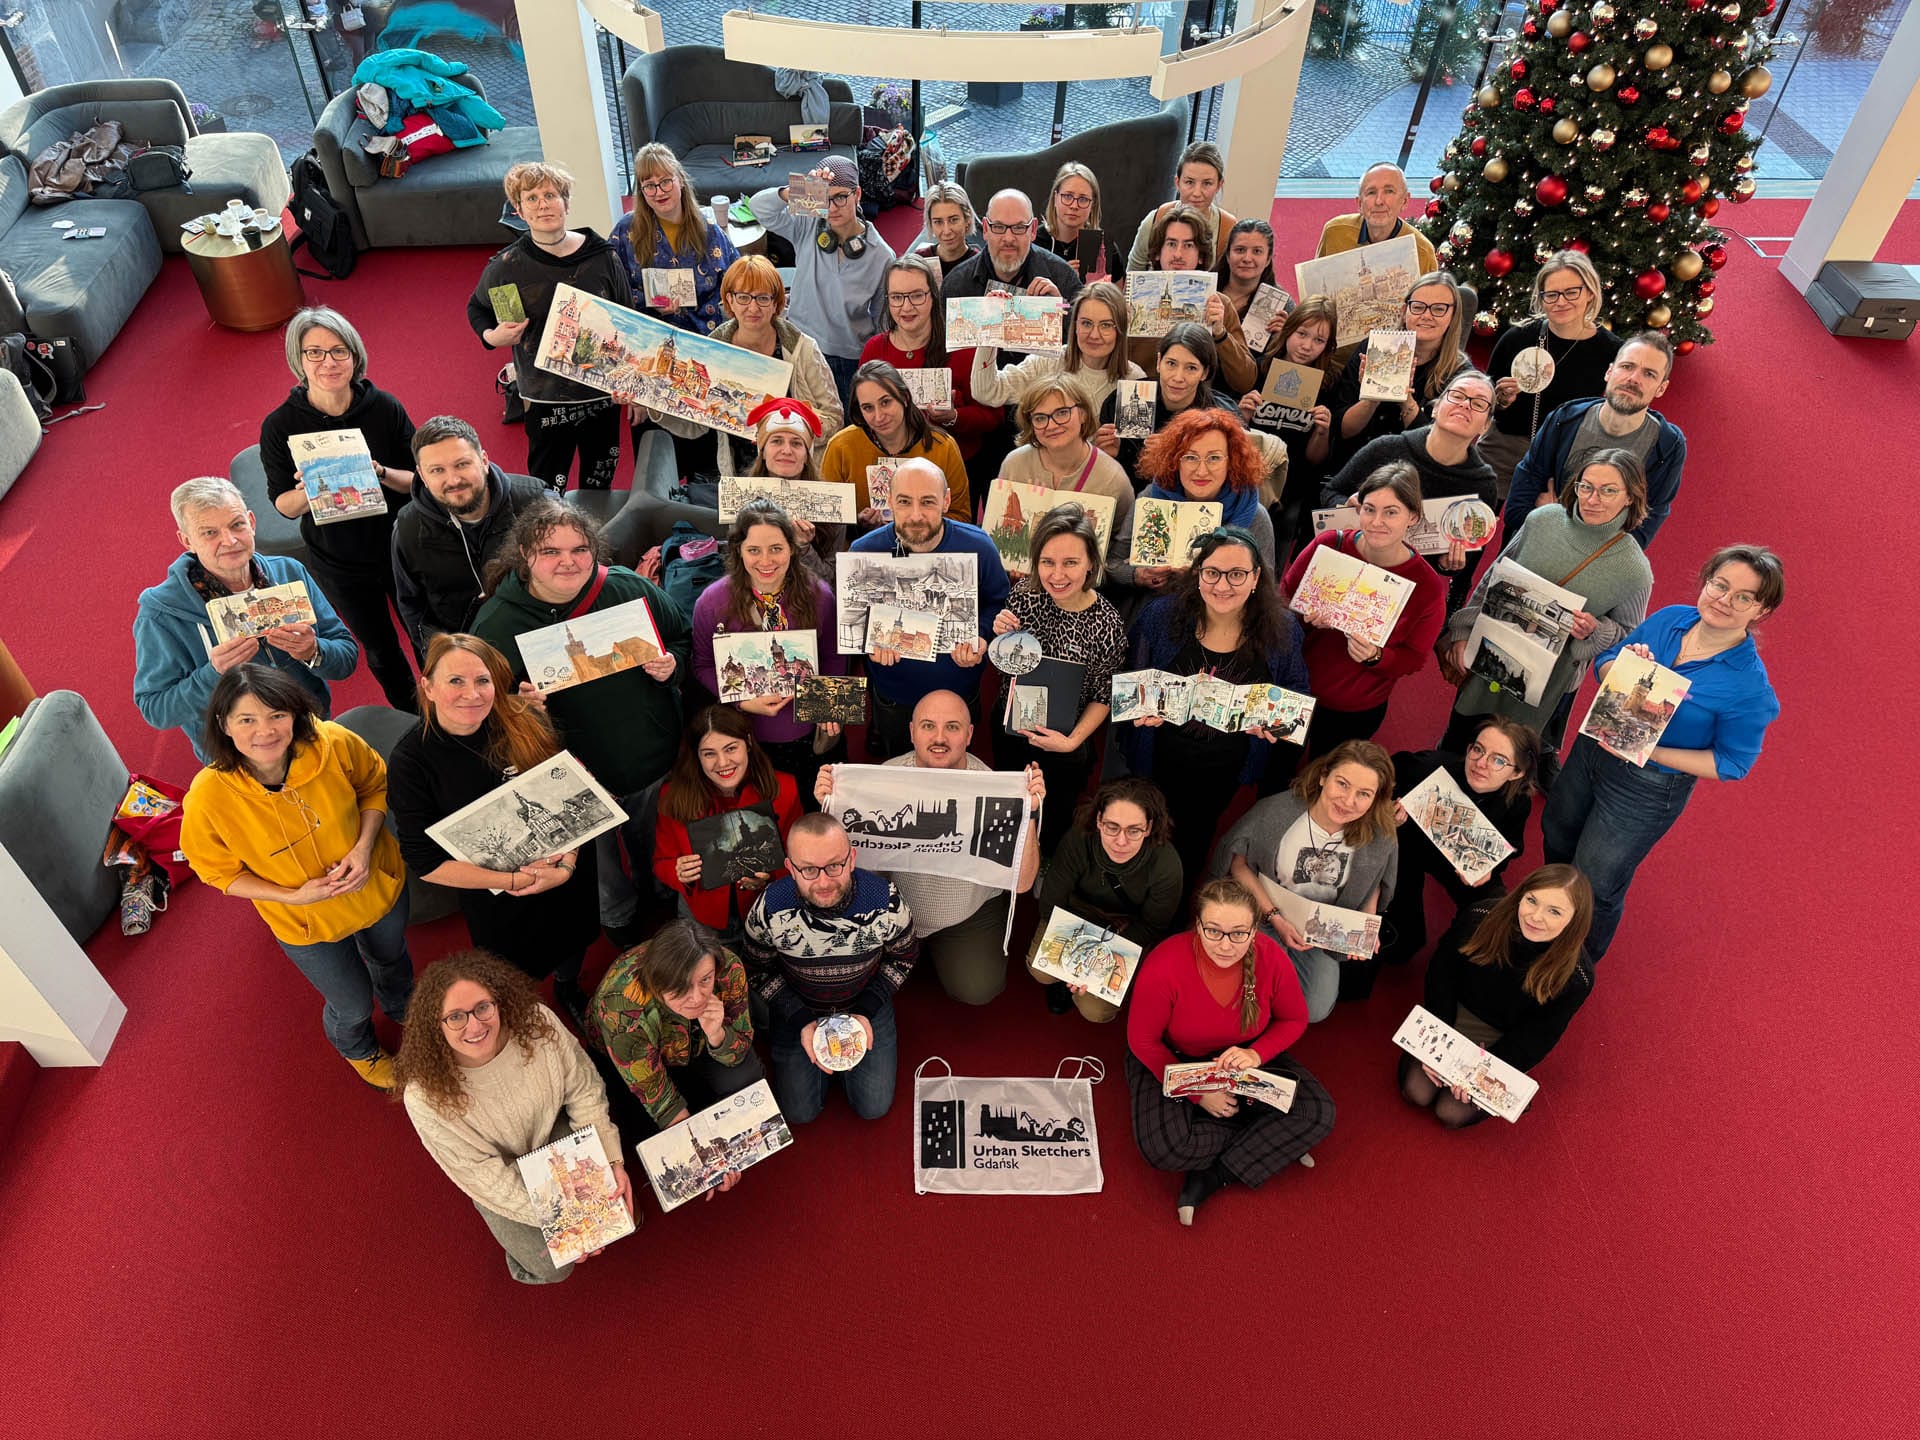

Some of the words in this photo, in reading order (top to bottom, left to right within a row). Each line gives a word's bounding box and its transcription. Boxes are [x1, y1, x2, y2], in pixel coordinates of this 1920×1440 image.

[973, 1145, 1017, 1157] Urban
[1021, 1145, 1091, 1157] Sketchers
[973, 1157, 1019, 1170] Gdańsk
